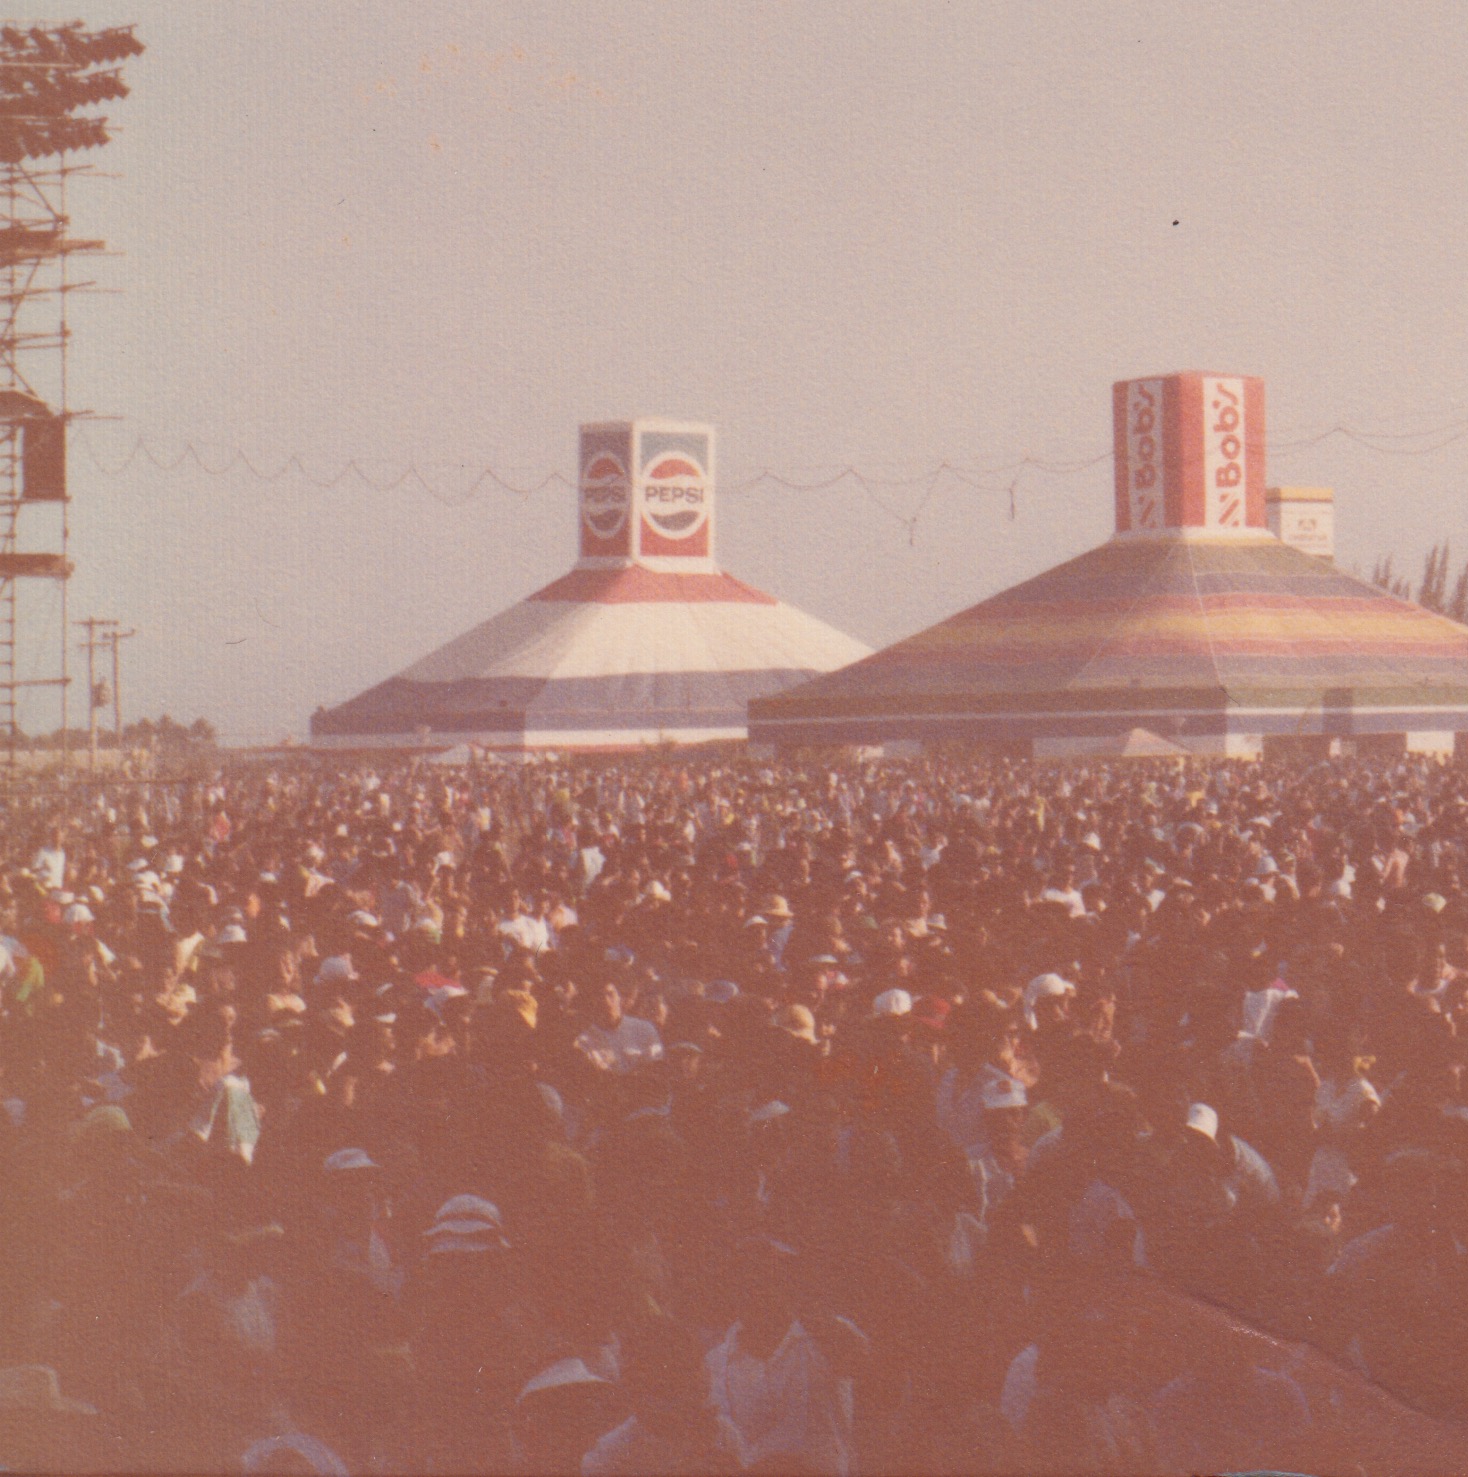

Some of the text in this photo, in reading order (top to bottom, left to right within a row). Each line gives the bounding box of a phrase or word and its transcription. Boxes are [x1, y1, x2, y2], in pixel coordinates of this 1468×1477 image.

[1132, 382, 1156, 489] Bob's
[1212, 382, 1242, 488] Bob's
[645, 486, 705, 504] PEPSI
